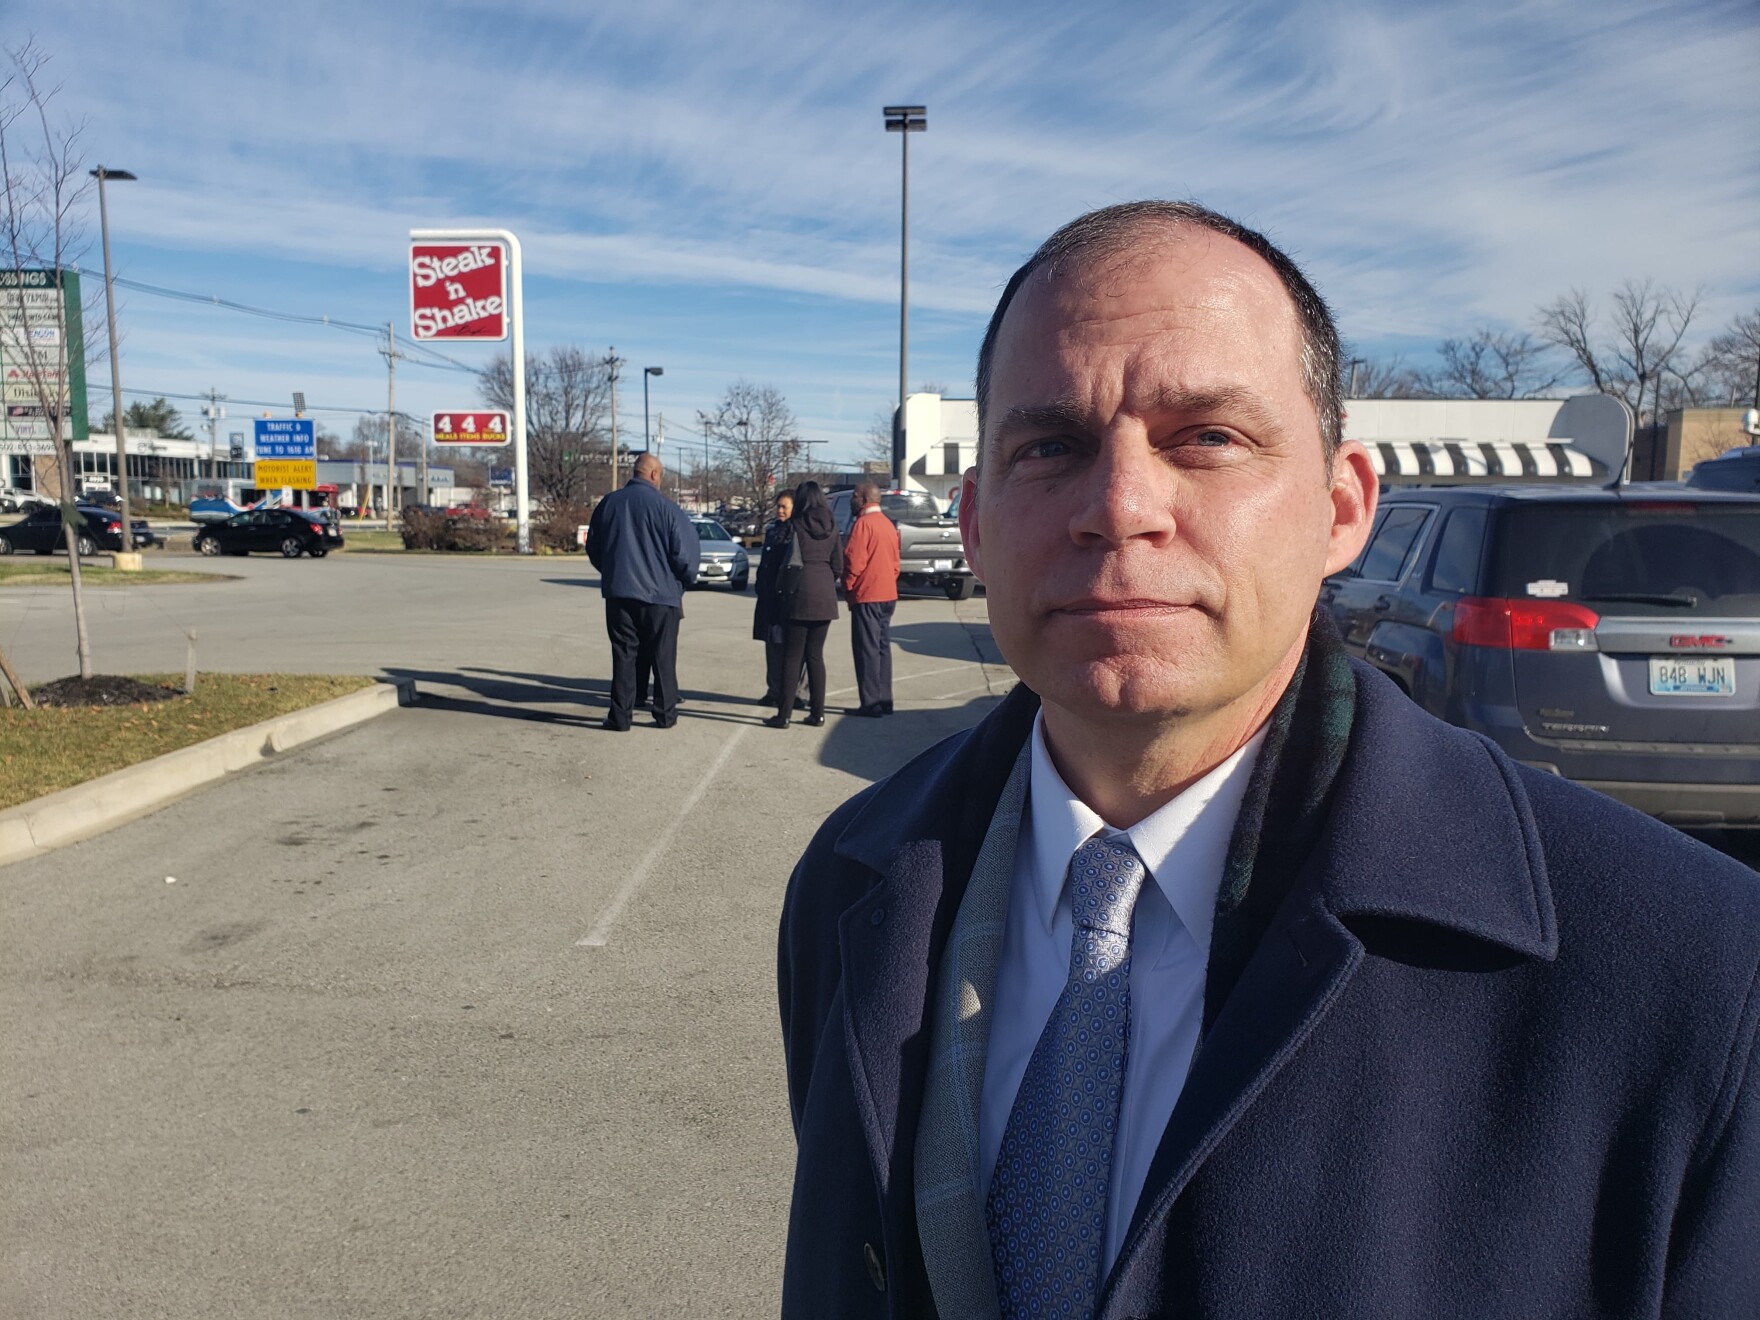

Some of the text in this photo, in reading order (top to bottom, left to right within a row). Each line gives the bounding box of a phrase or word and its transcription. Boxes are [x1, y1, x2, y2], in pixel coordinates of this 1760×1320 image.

[413, 246, 495, 288] Steak
[414, 295, 503, 338] Shake
[266, 421, 293, 431] TRAFFIC
[438, 415, 503, 433] 4 4 4
[259, 433, 310, 443] WEATHER INFO
[275, 444, 284, 455] TO
[257, 464, 313, 473] MOTORIST ALERT
[1670, 633, 1726, 649] GMC
[1697, 666, 1725, 685] WJN
